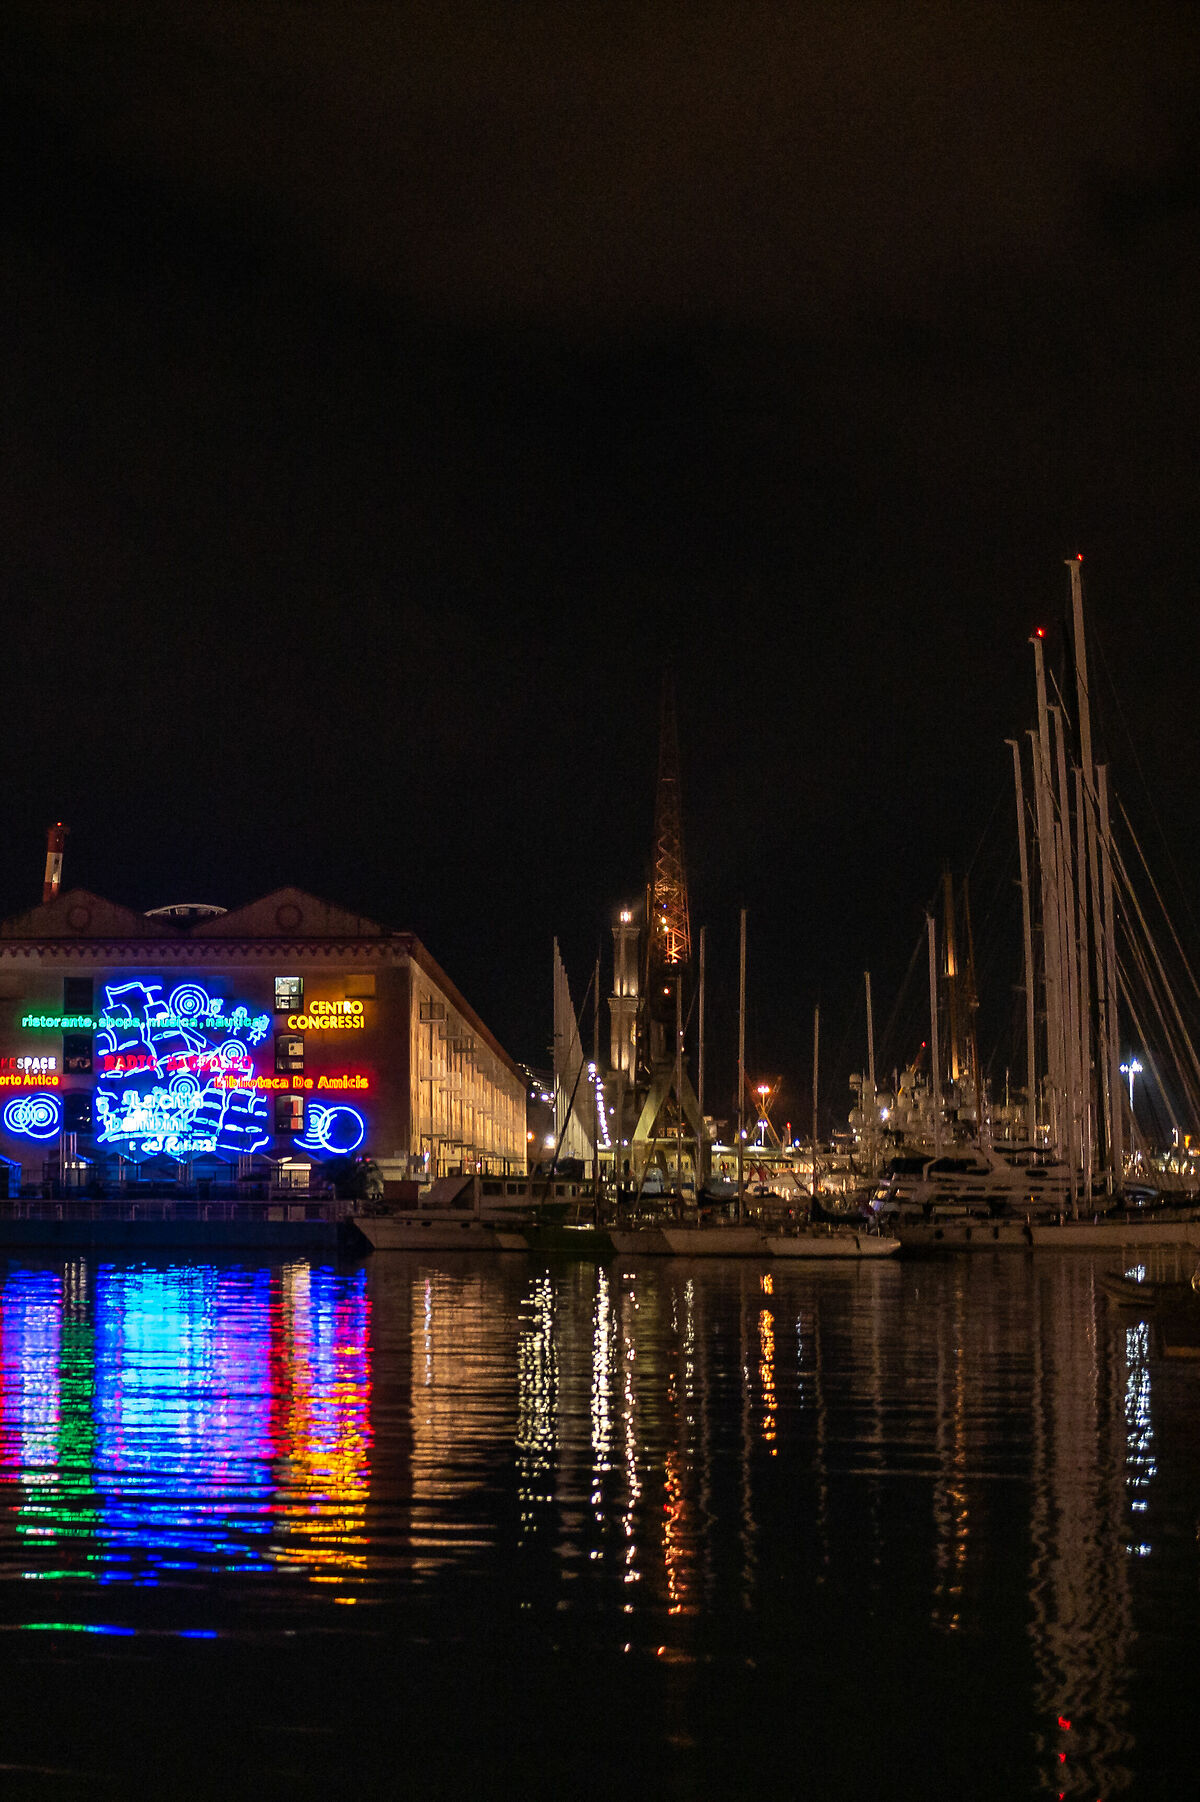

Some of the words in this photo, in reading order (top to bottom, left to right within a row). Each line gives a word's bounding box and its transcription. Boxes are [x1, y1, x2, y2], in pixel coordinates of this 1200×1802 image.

[309, 1000, 364, 1015] CENTRO
[287, 1015, 365, 1030] CONGRESSI
[103, 1054, 158, 1072] RADIO
[23, 1073, 59, 1086] Antico
[214, 1075, 289, 1089] Biblioteca
[293, 1075, 314, 1089] De
[317, 1074, 369, 1089] Amicis
